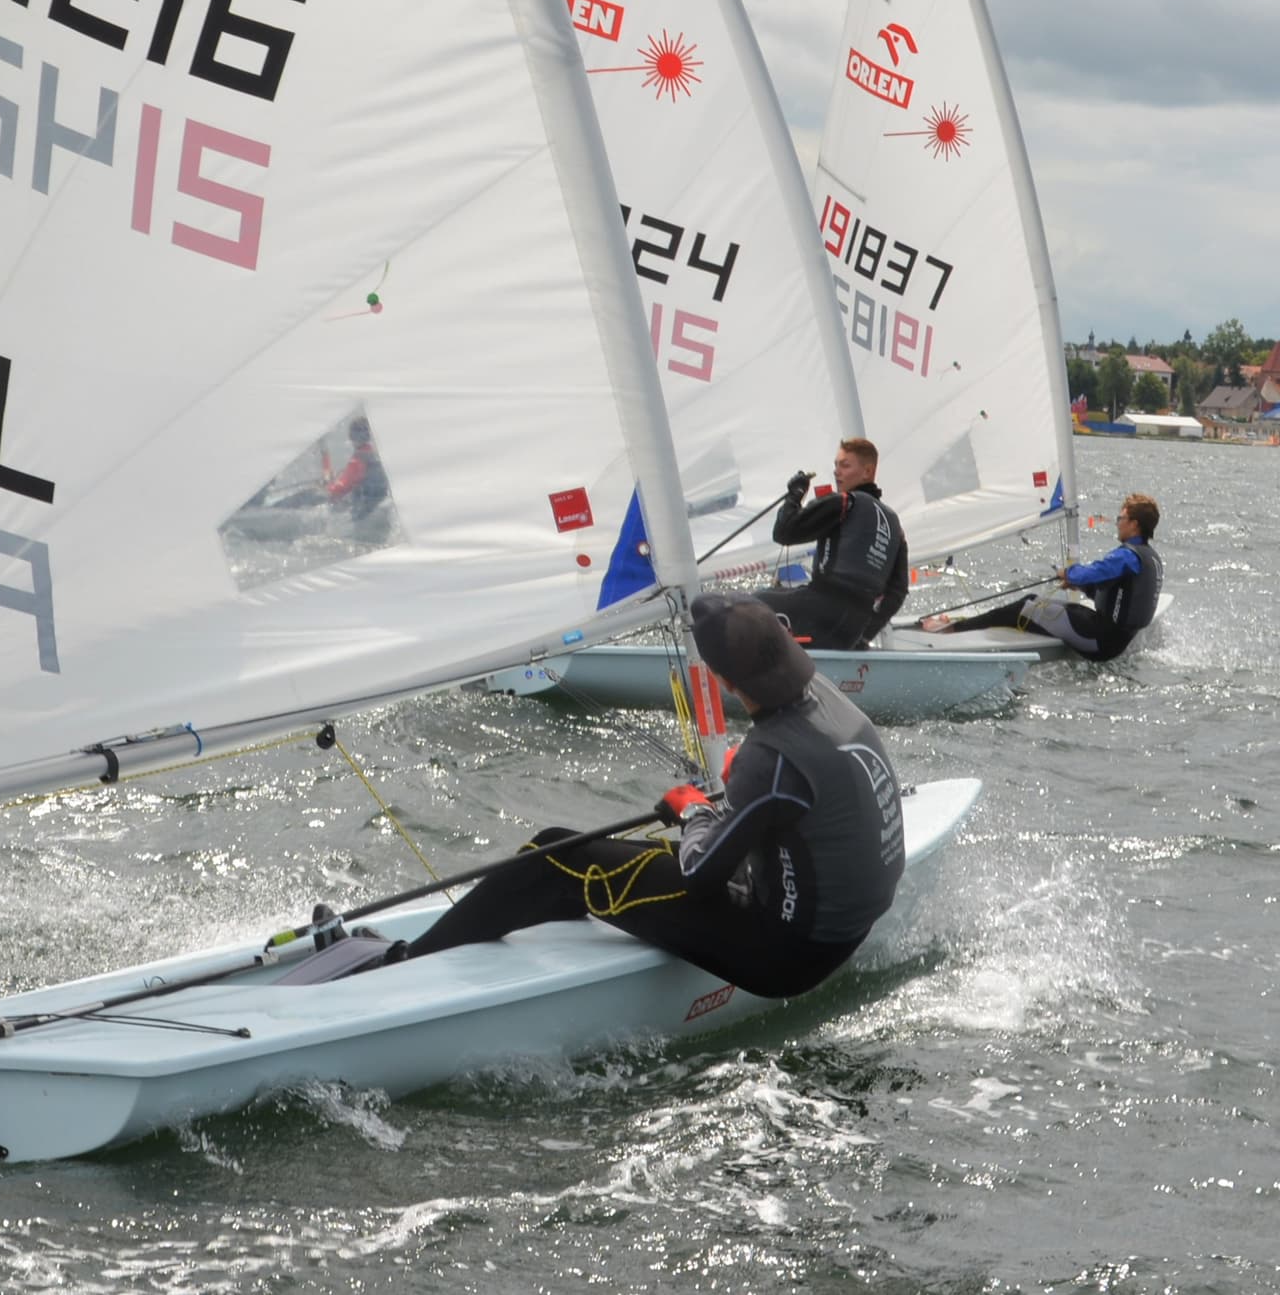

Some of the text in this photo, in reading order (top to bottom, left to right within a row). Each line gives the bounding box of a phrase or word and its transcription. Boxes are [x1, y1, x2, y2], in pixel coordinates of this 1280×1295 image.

[849, 55, 907, 104] ORLEN
[620, 204, 740, 302] 24
[820, 195, 953, 311] 191837
